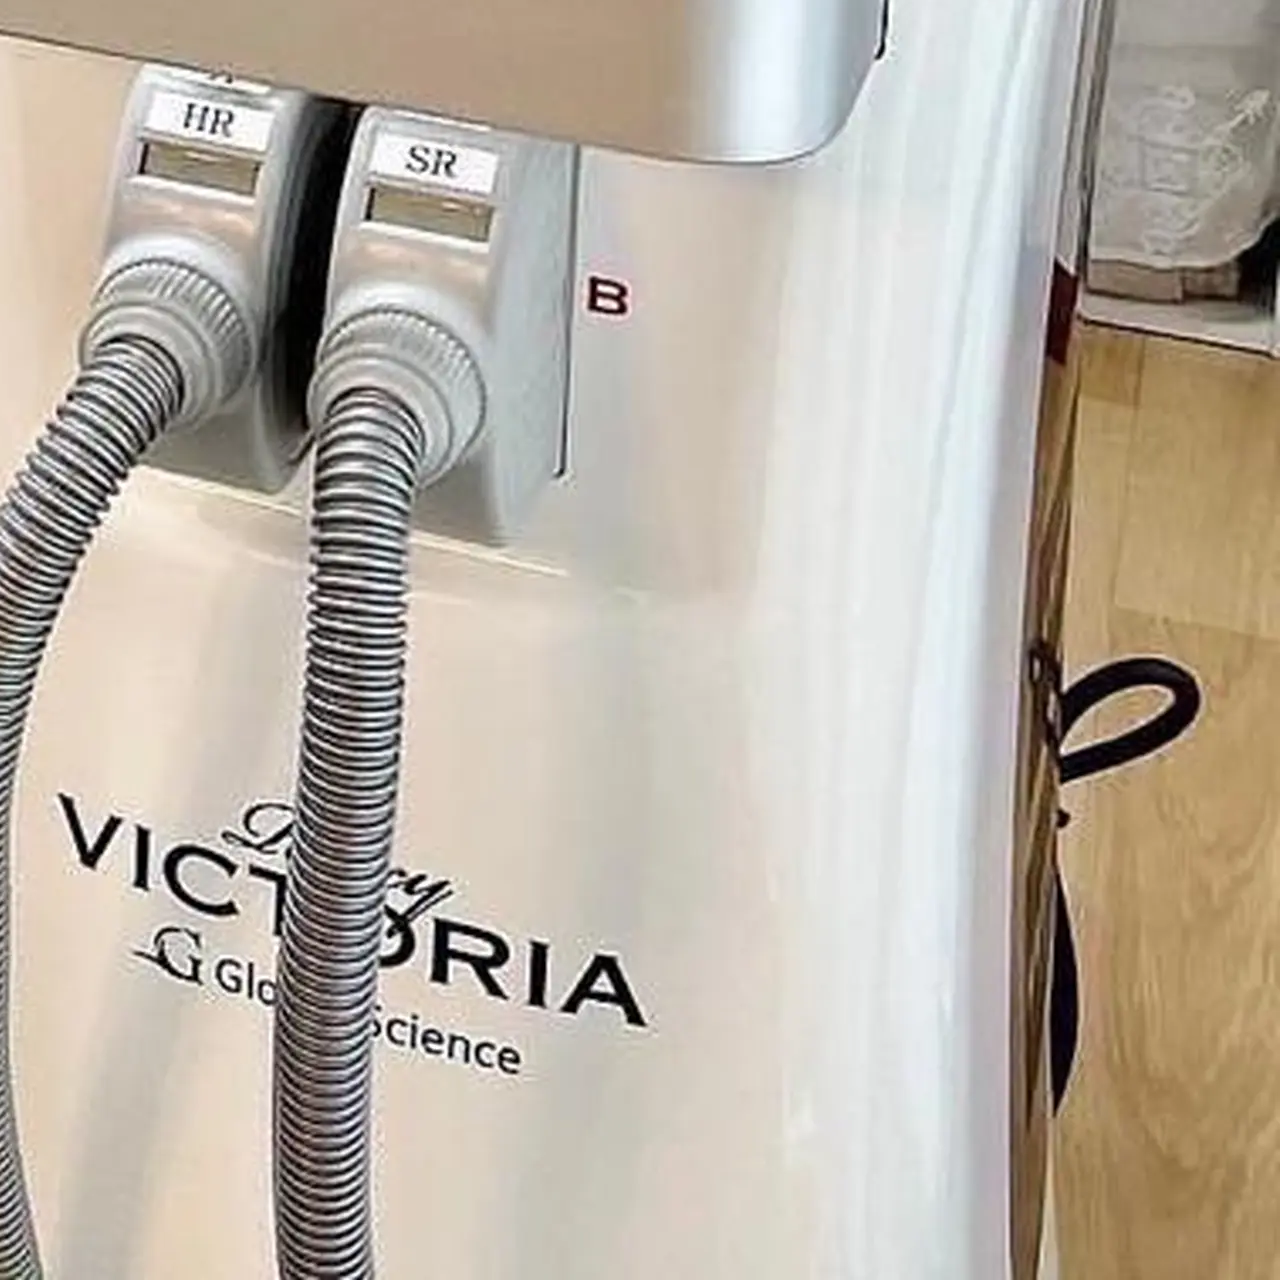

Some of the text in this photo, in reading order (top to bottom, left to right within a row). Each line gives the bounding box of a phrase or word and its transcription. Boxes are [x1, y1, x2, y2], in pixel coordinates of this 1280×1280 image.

[183, 102, 235, 138] HR
[404, 144, 459, 179] SR
[587, 276, 629, 317] B
